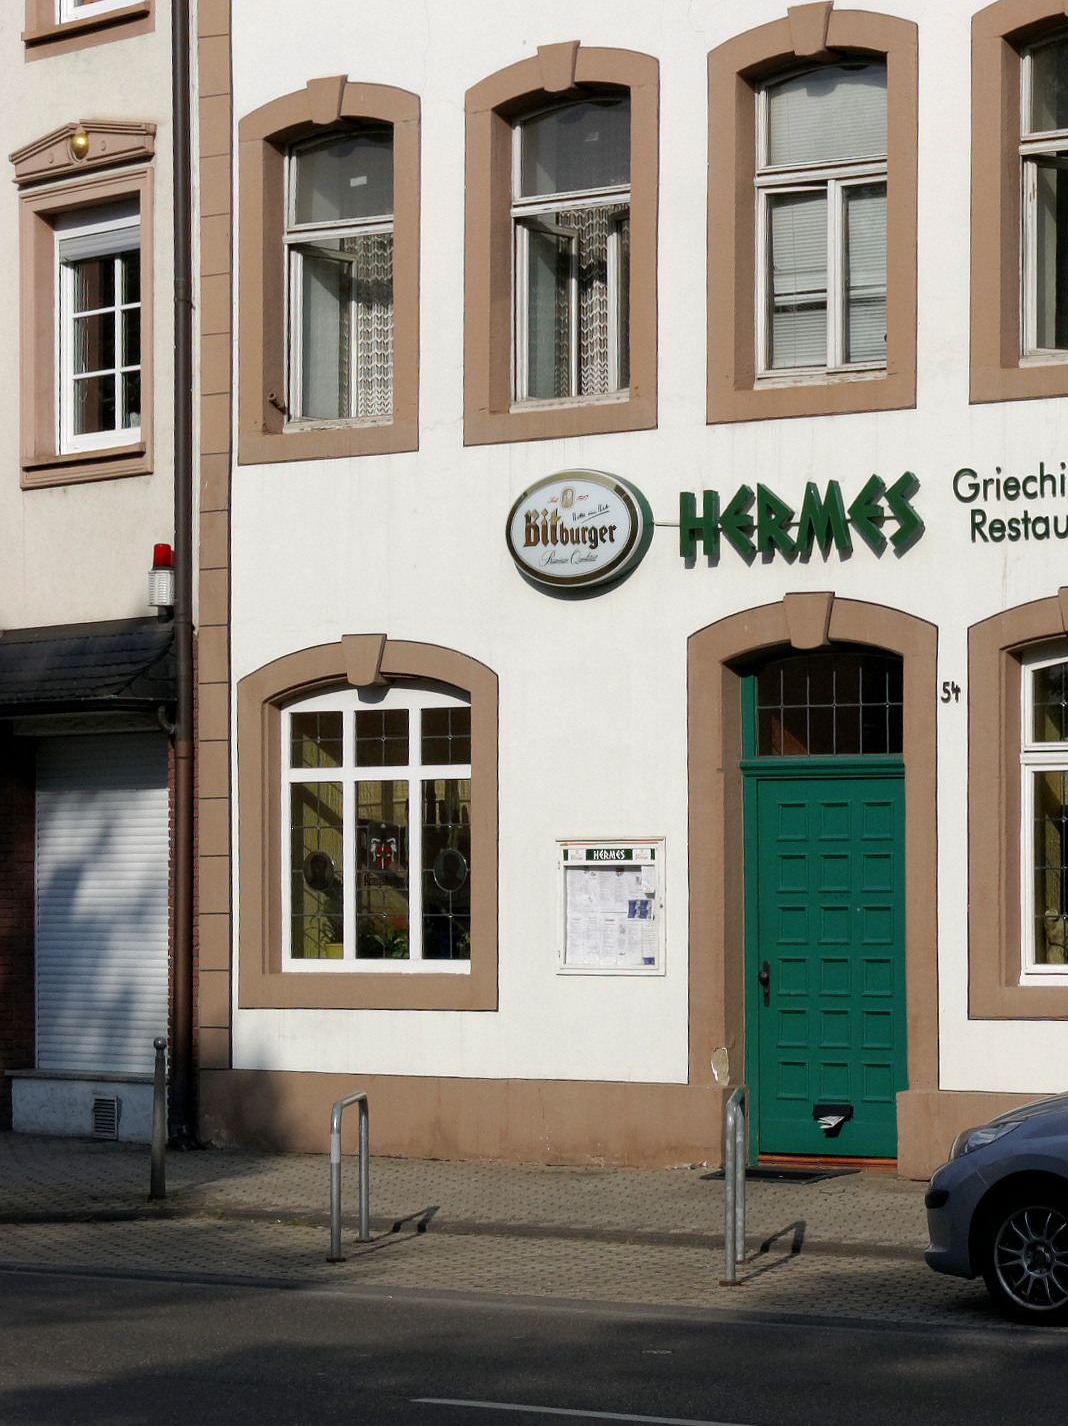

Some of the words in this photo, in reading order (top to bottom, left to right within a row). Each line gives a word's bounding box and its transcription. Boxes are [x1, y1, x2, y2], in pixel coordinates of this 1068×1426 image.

[523, 508, 617, 549] Bitburger
[680, 471, 923, 559] HERMES
[941, 681, 961, 703] 54
[594, 850, 625, 860] HERMES
